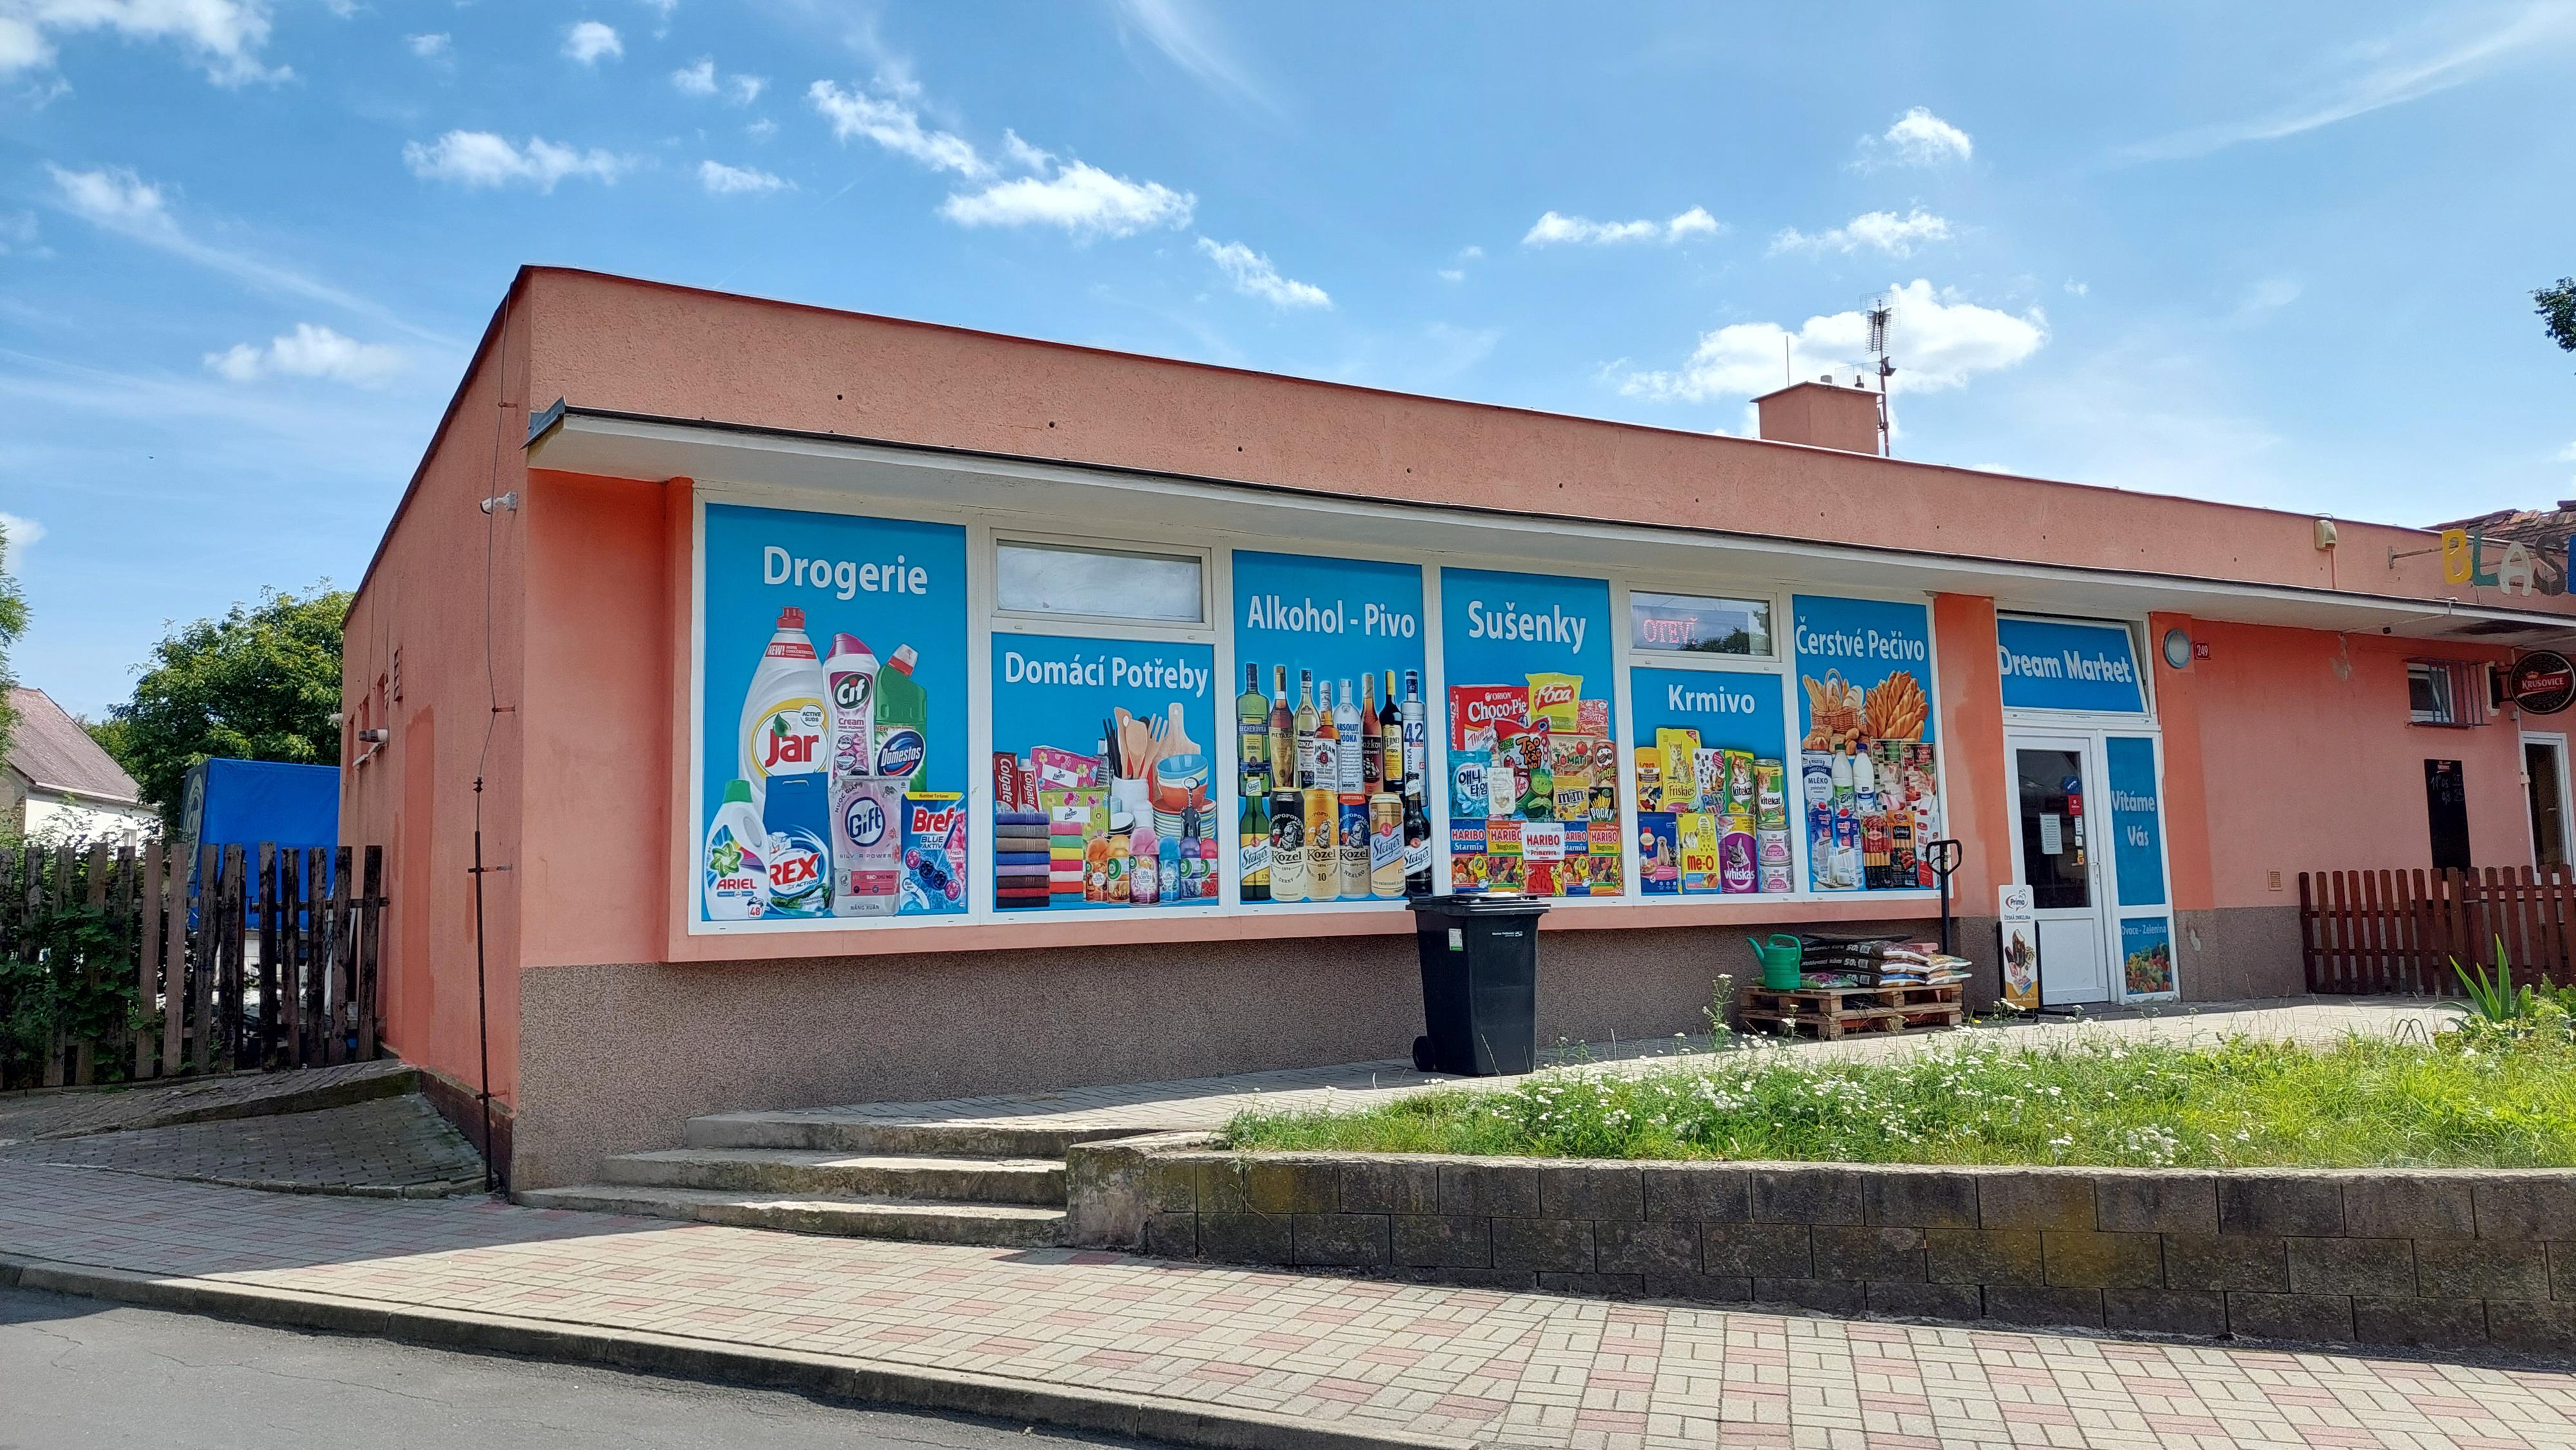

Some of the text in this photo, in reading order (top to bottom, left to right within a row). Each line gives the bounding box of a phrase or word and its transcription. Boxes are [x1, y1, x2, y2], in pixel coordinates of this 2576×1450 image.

[764, 546, 928, 601] Drogerie
[1247, 594, 1343, 634] Alkohol
[1365, 603, 1416, 639] Pivo
[1467, 599, 1587, 655] Sušenky
[1795, 615, 1925, 662] Čerstvé Pečivo
[2197, 645, 2208, 656] 249
[1998, 645, 2132, 683] Dream Market
[1005, 652, 1209, 699] Domácí Potřeby
[837, 677, 866, 704] Cif
[1492, 692, 1511, 701] ORION
[1668, 684, 1756, 714] Krmivo
[838, 717, 864, 726] Cream
[1337, 723, 1359, 731] ABSOLUT
[1404, 722, 1423, 748] 42
[764, 728, 820, 767] Jar
[880, 746, 922, 767] Domestos
[999, 757, 1012, 804] Colgate
[1023, 772, 1035, 805] Colgate
[1669, 785, 1695, 797] Friskies
[1732, 786, 1752, 796] kitekat
[1760, 796, 1781, 805] kitekat
[1839, 793, 1853, 804] Bio
[2111, 789, 2156, 813] Vítáme
[849, 806, 882, 839] Gift
[912, 807, 955, 832] Bref
[1452, 829, 1485, 841] HARIBO
[1526, 834, 1560, 846] HARIBO
[1565, 831, 1587, 842] ARIBO
[1591, 831, 1618, 843] HARIBO
[2126, 824, 2150, 847] Vás
[1373, 836, 1402, 859] Steiger
[1454, 842, 1484, 851] Starmix
[1242, 848, 1269, 868] Steiger
[1271, 850, 1302, 865] Kozel
[1307, 849, 1336, 862] Kozel
[1340, 849, 1369, 862] Kozel
[1404, 848, 1429, 867] Steiger
[1687, 854, 1714, 871] Me-O
[770, 853, 820, 886] REX
[1317, 873, 1327, 881] 10
[1343, 869, 1365, 878] NEALKO
[1723, 868, 1755, 880] whiskas
[716, 878, 757, 890] ARIEL
[795, 878, 819, 889] ACTION
[750, 907, 761, 916] 48
[2142, 923, 2167, 934] Zelenina
